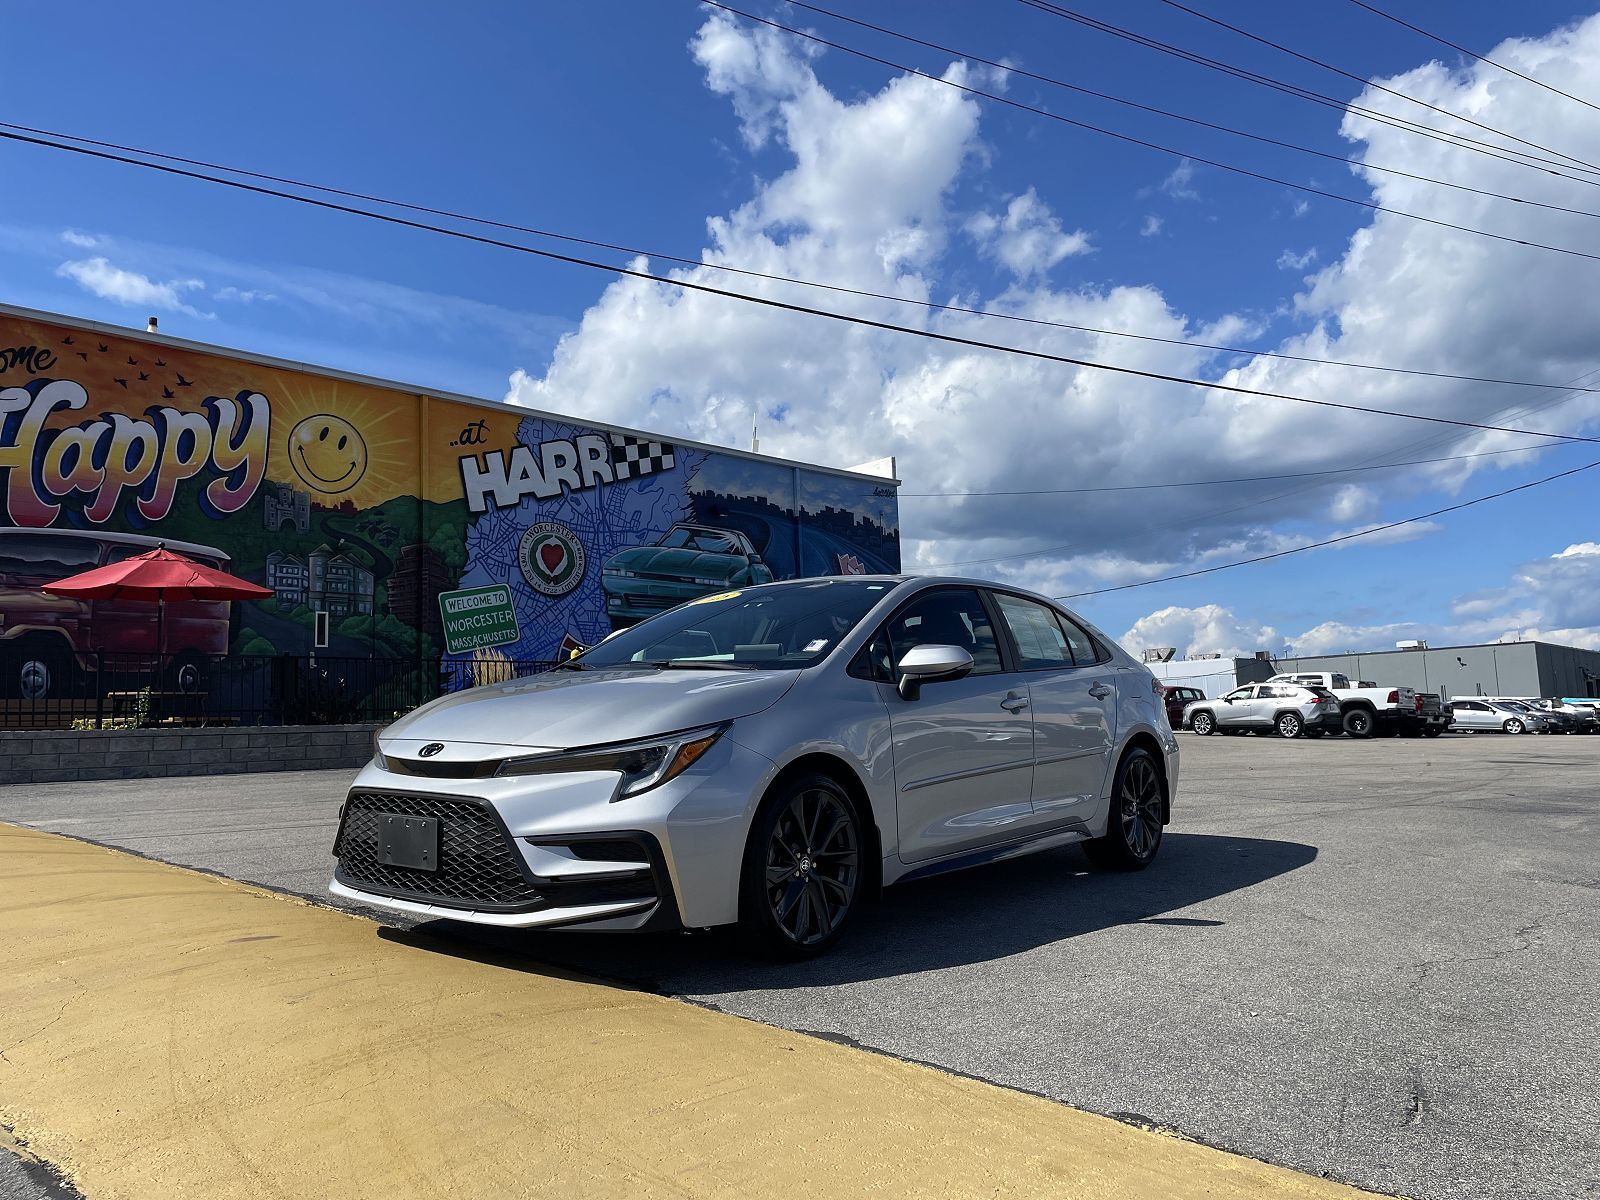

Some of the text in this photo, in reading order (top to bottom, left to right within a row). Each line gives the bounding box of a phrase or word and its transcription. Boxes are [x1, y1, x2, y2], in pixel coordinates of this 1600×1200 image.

[526, 523, 577, 543] WORCESTER
[447, 592, 505, 611] WELCOME TO
[447, 610, 514, 633] WORCESTER
[451, 629, 516, 650] MASSACHUSETTS
